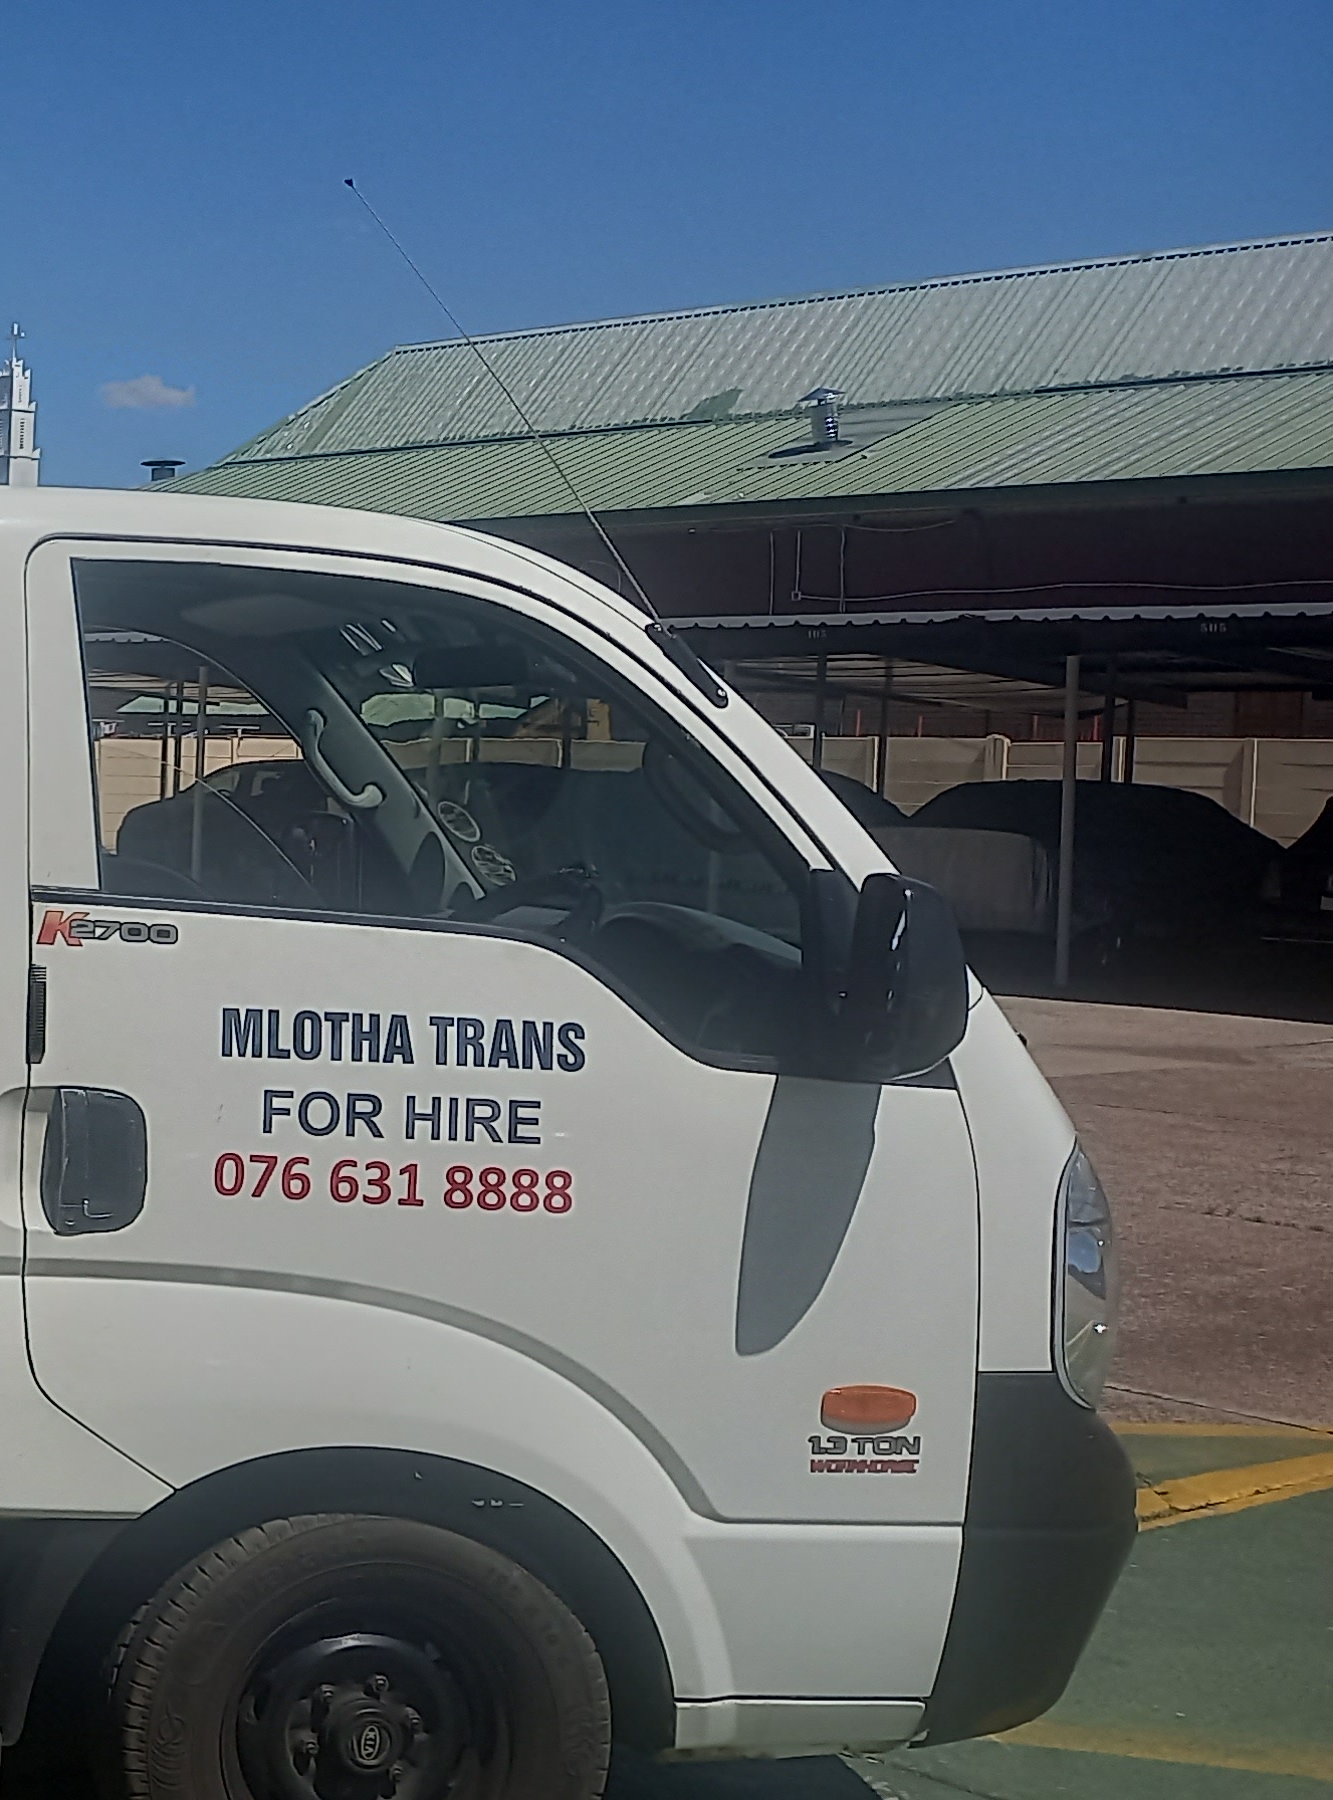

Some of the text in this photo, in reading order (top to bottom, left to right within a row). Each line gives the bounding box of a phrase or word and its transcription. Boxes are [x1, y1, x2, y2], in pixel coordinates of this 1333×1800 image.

[36, 910, 179, 947] K2700
[222, 1008, 586, 1072] MLOTHA TRANS
[262, 1090, 542, 1144] FOR HIRE
[214, 1153, 573, 1213] 076 631 8888
[808, 1436, 921, 1455] 1.3 TON
[364, 1732, 376, 1754] KIA
